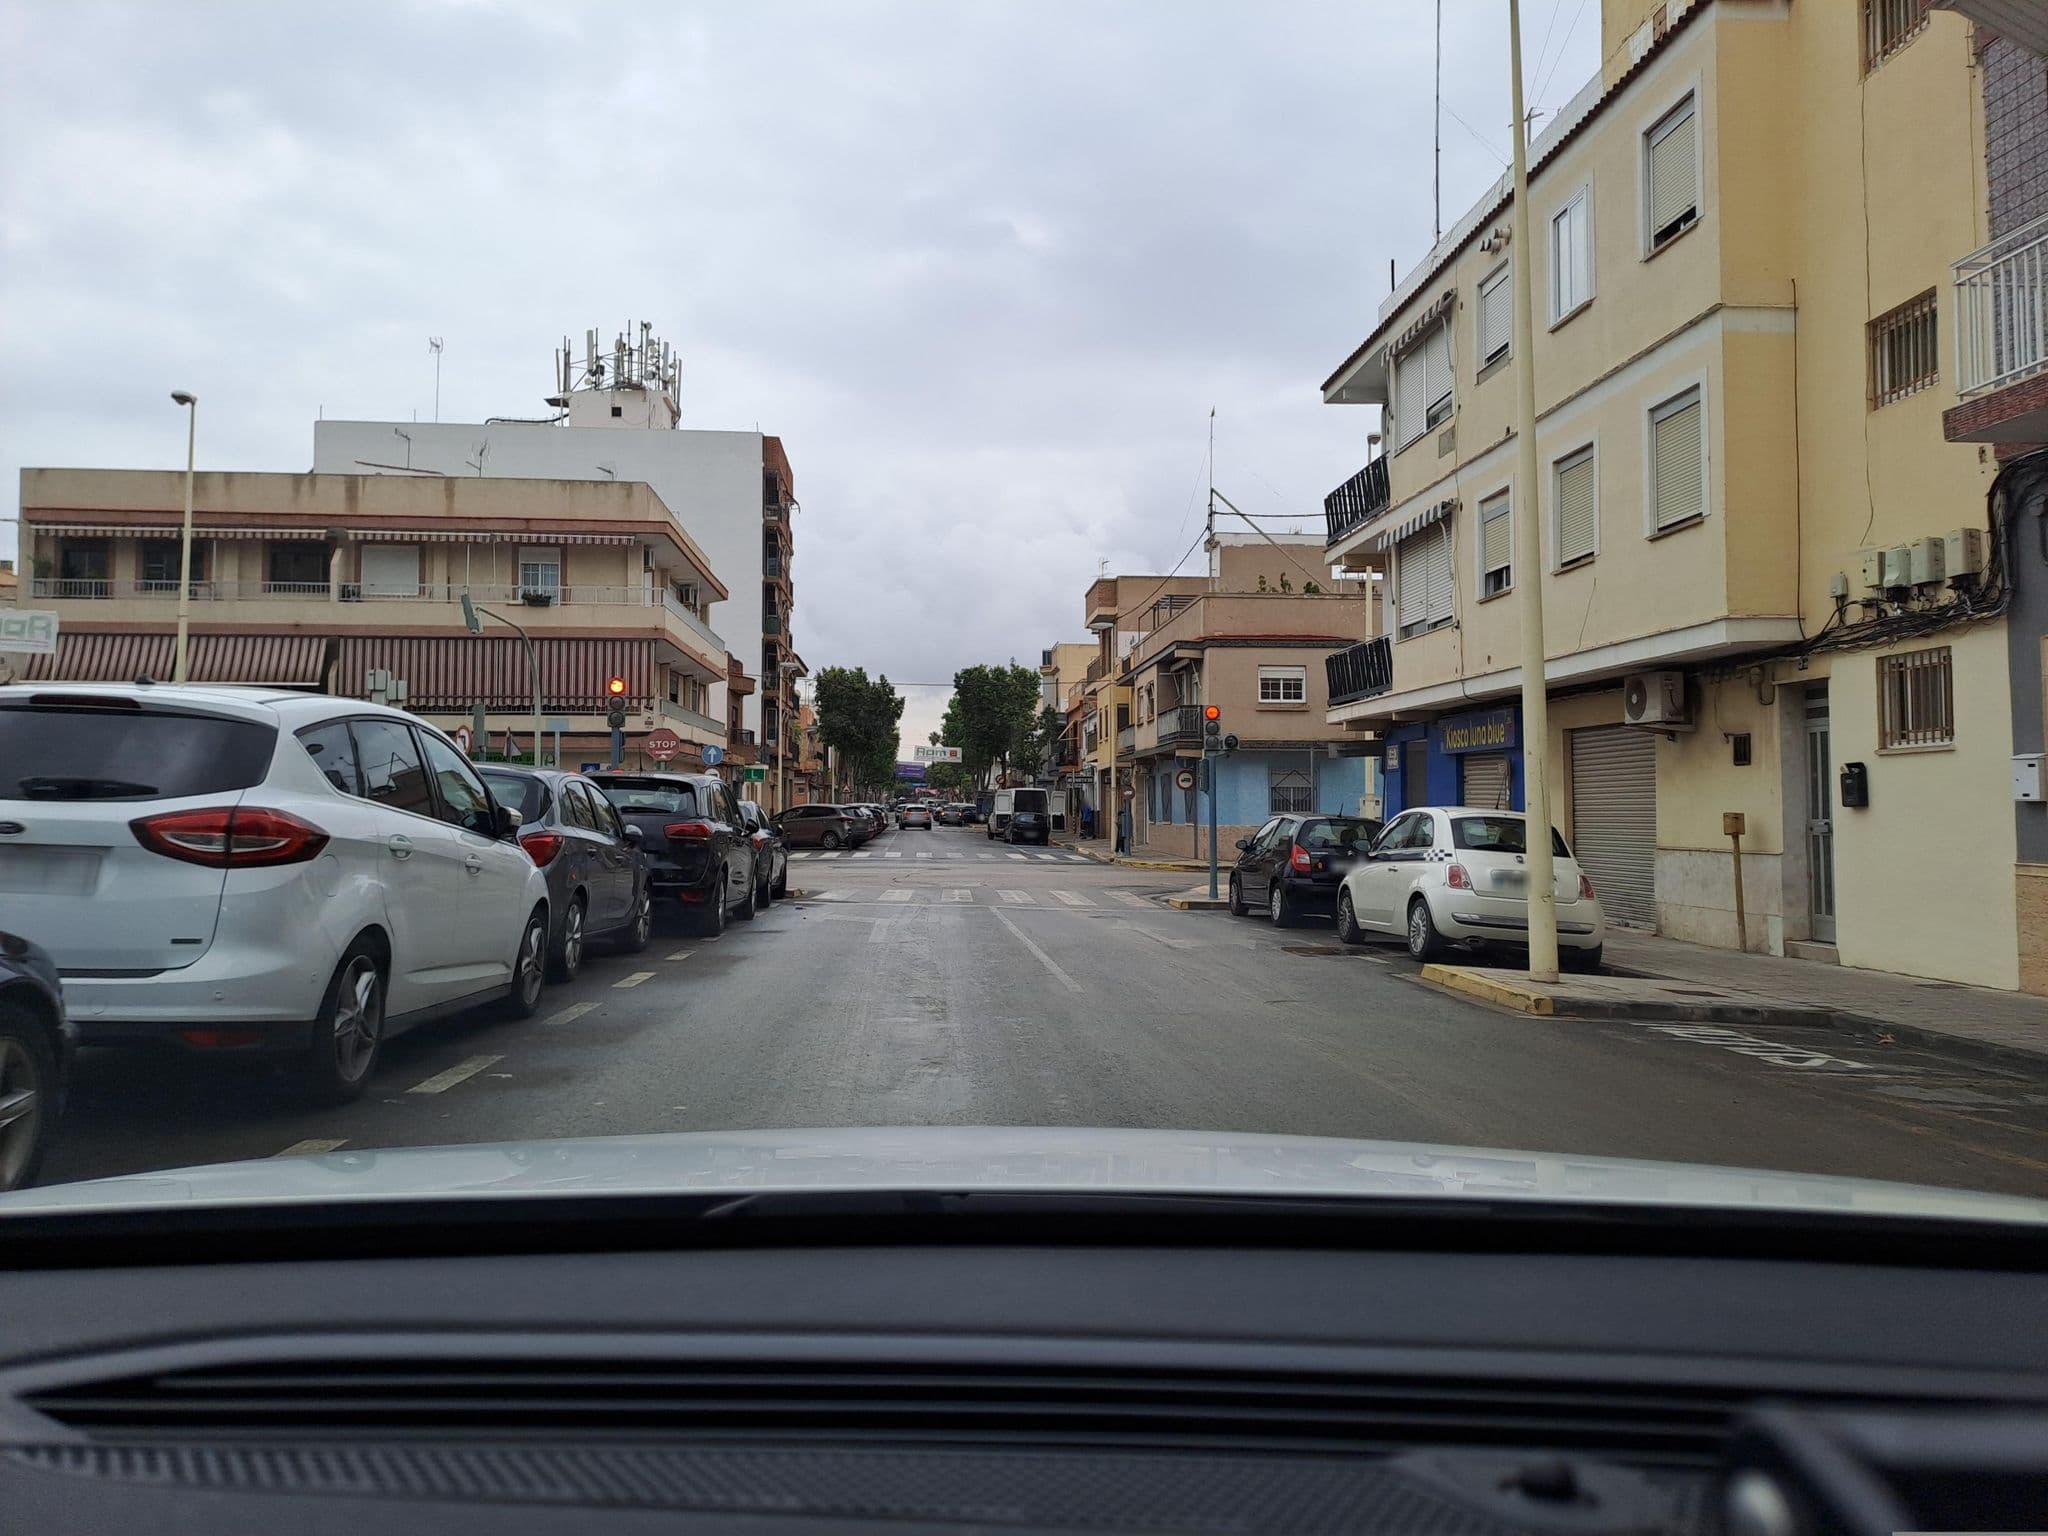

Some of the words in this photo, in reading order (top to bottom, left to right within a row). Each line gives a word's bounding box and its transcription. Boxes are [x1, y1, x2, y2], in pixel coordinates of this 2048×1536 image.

[1446, 725, 1469, 750] Kiosco
[1470, 719, 1486, 746] luna
[1488, 716, 1505, 745] blue
[649, 740, 677, 748] STOP
